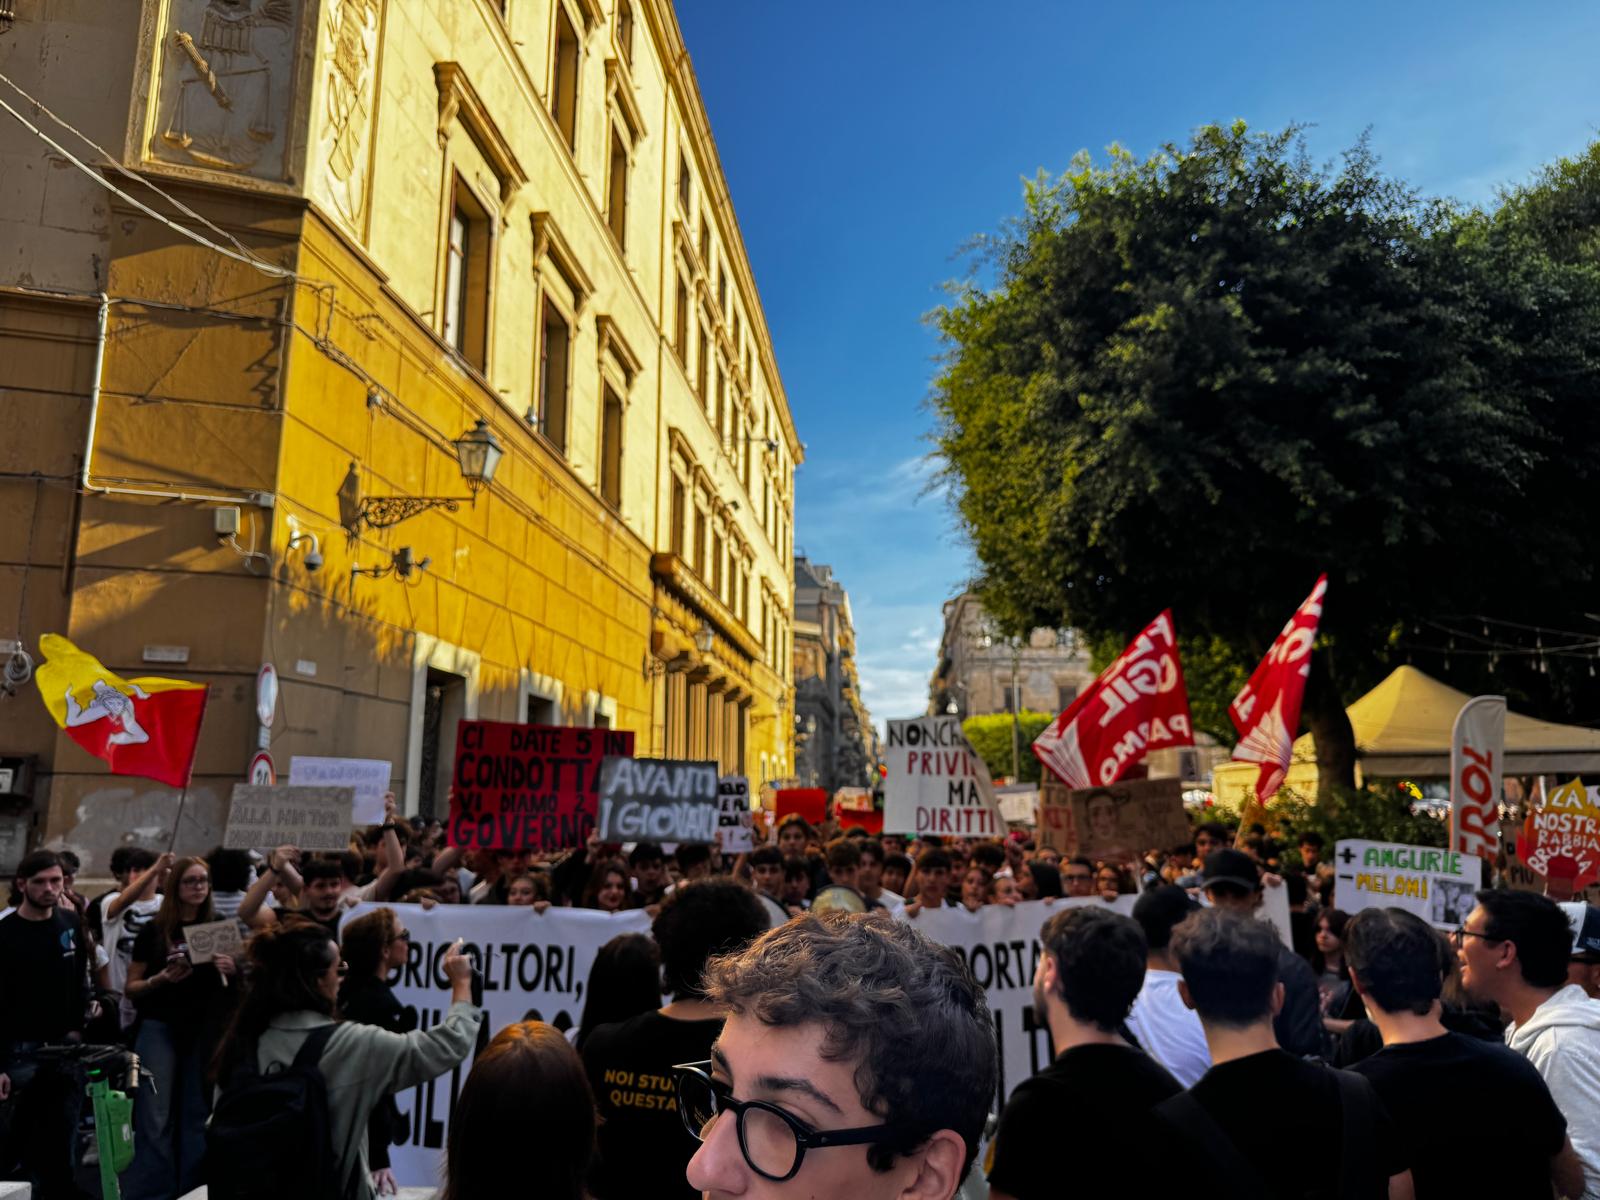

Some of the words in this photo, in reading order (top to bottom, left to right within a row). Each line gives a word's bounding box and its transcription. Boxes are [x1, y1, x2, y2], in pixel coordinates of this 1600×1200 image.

[462, 725, 484, 749] CI
[511, 729, 562, 753] DATE
[575, 731, 592, 754] 5
[604, 732, 626, 755] IN
[607, 758, 717, 798] AVANTI
[458, 791, 483, 811] VI
[948, 780, 981, 806] MA
[1551, 788, 1583, 809] LA
[916, 806, 995, 833] DIRITTI
[1534, 813, 1600, 834] NOSTR
[1363, 848, 1462, 875] ANGURIE
[604, 1069, 634, 1086] NOI
[638, 1074, 676, 1092] STU
[610, 1089, 677, 1112] QUESTA
